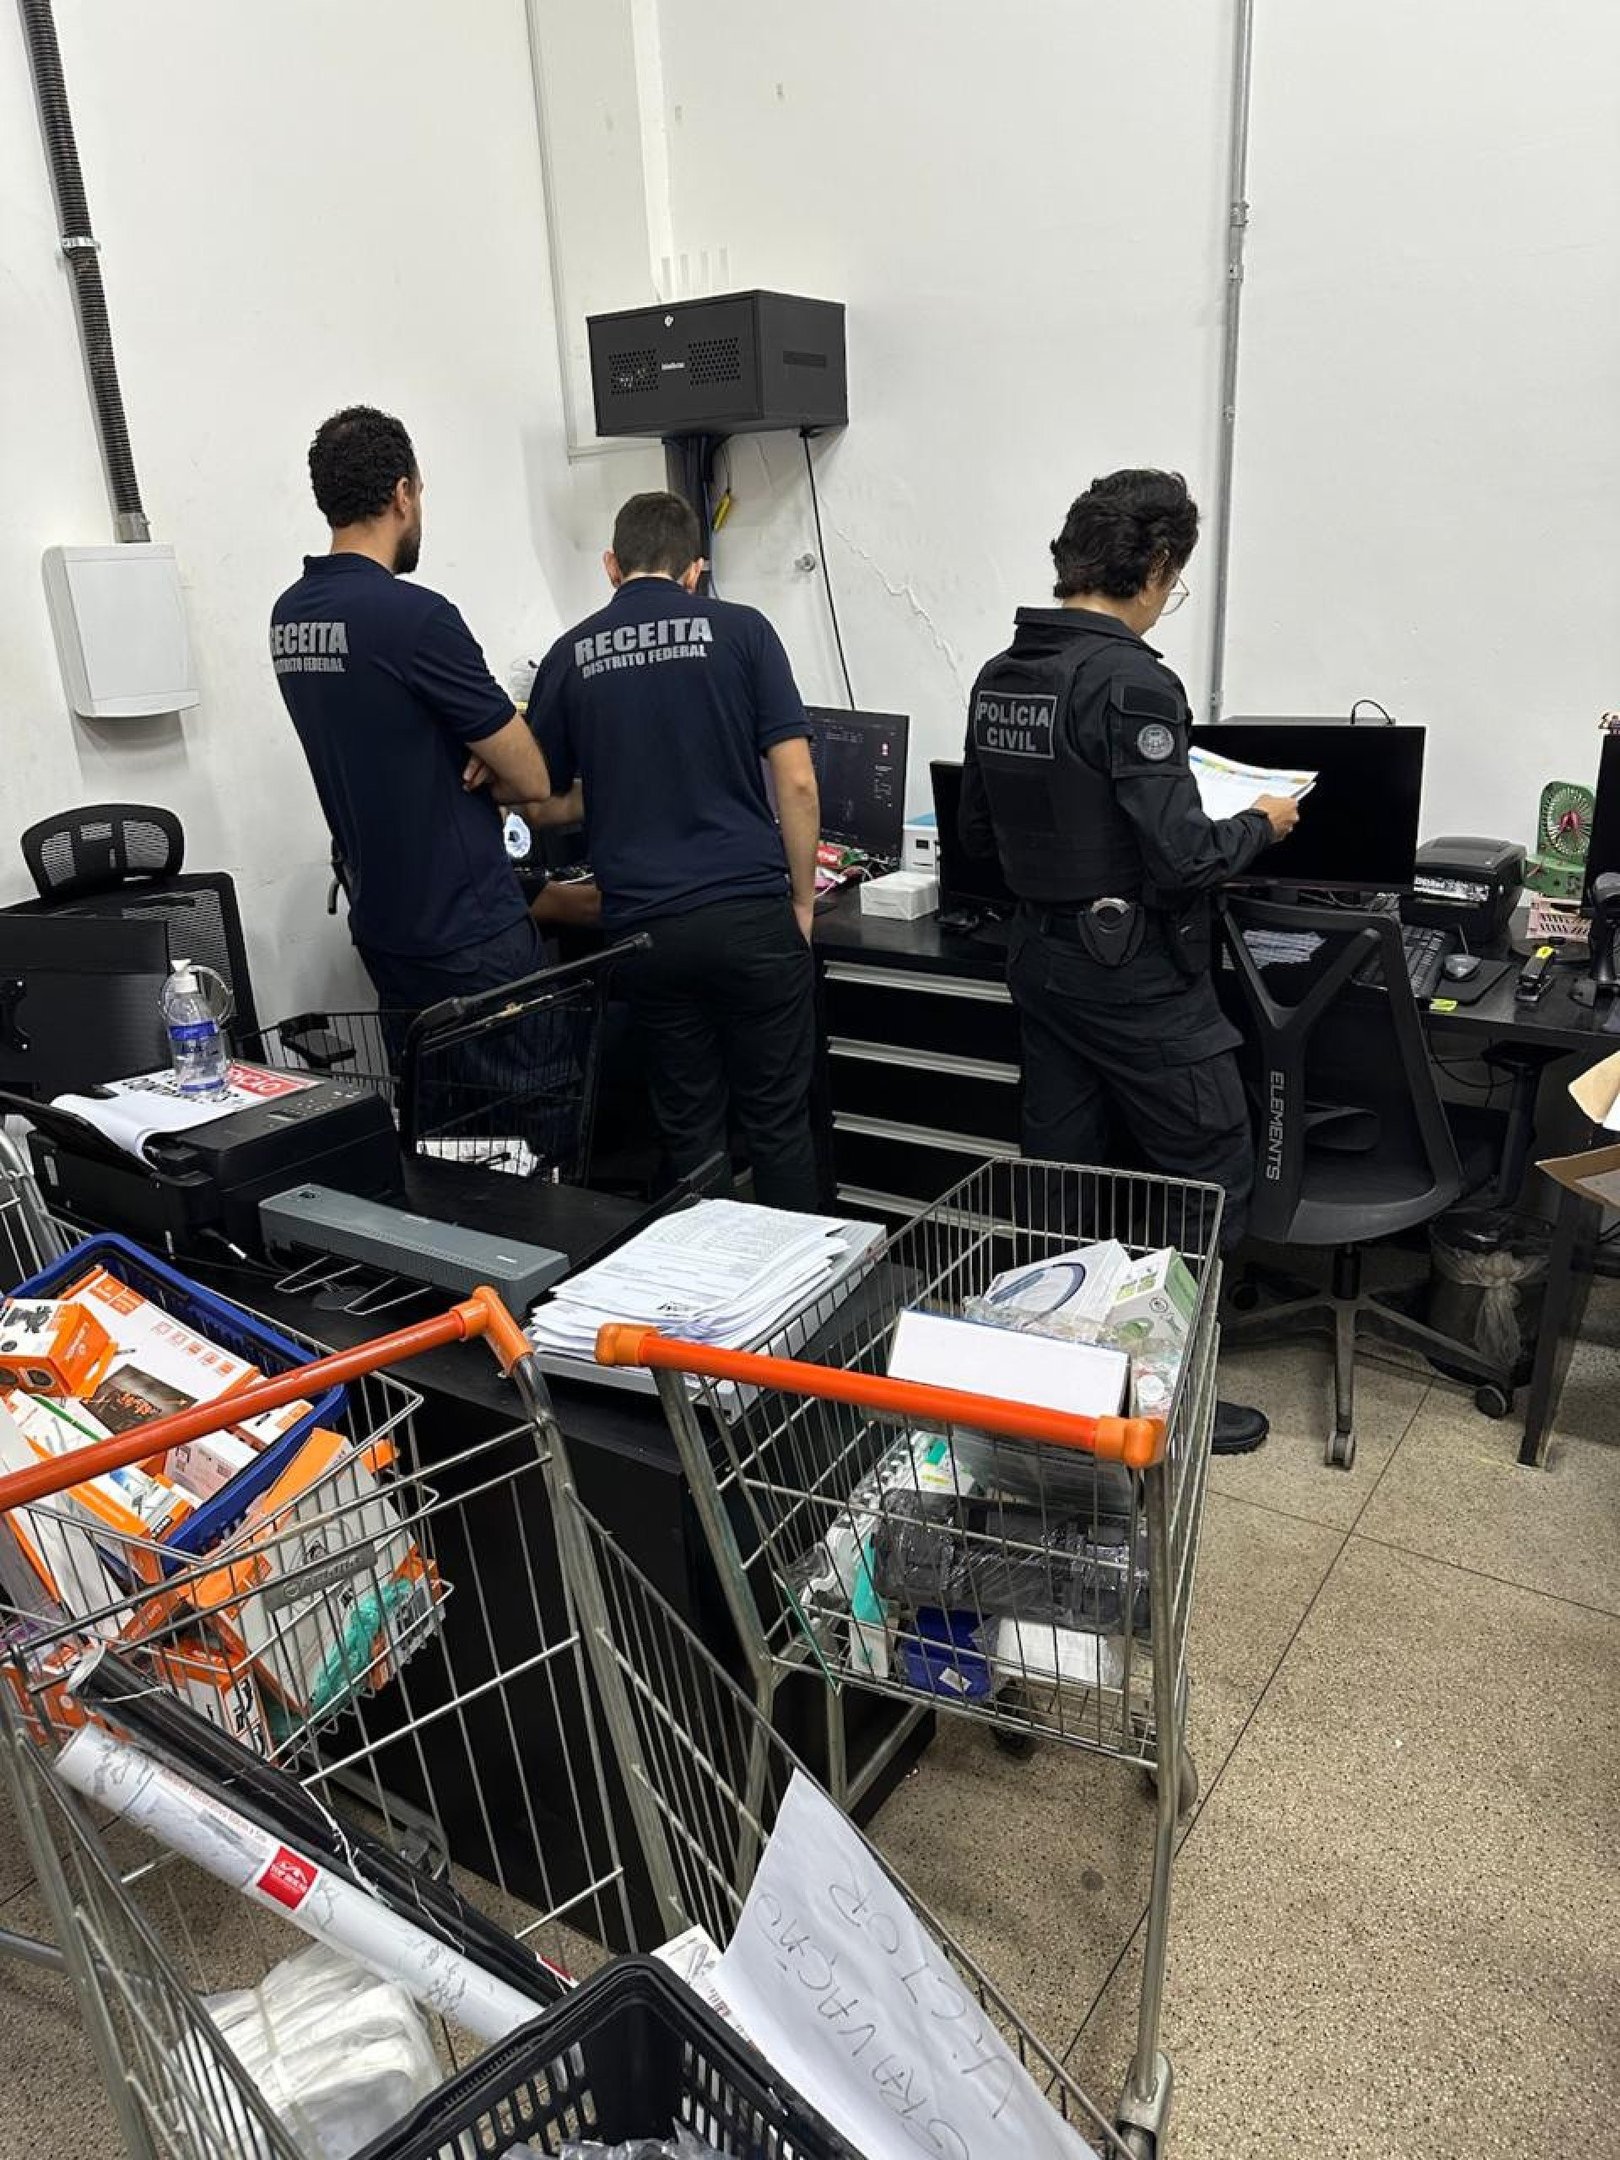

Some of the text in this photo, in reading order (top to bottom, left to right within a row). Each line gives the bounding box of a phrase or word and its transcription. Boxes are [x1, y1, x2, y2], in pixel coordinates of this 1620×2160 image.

[574, 617, 713, 667] RECEITA
[582, 644, 707, 679] DISTRITO FEDERAL
[975, 701, 1048, 727] POLÍCIA
[987, 727, 1036, 751] CIVIL
[1266, 1071, 1285, 1181] ELEMENTS
